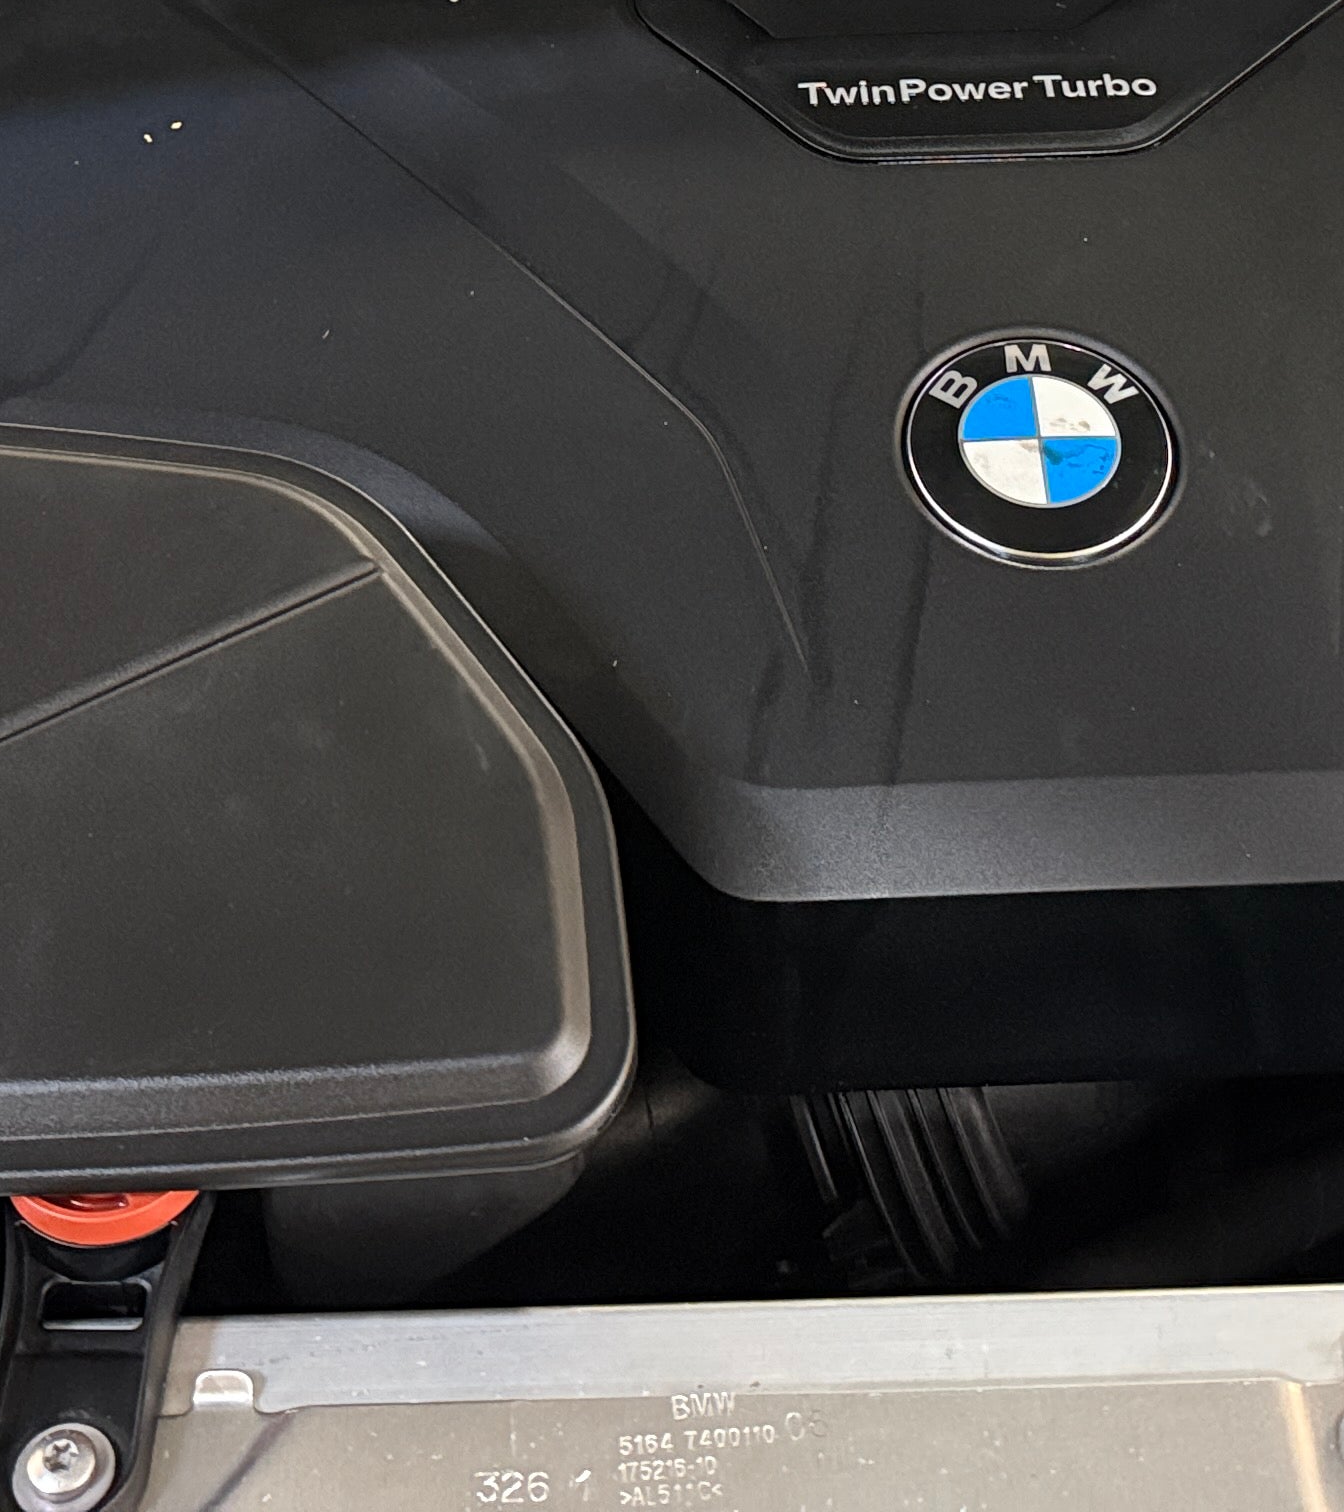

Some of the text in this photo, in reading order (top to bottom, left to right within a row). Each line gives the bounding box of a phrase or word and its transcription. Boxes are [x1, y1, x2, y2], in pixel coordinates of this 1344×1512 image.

[798, 73, 1157, 107] TwinPower Turbo
[928, 343, 1140, 409] BMW
[670, 1391, 737, 1421] BMW
[618, 1432, 674, 1456] 5164
[474, 1470, 550, 1503] 326
